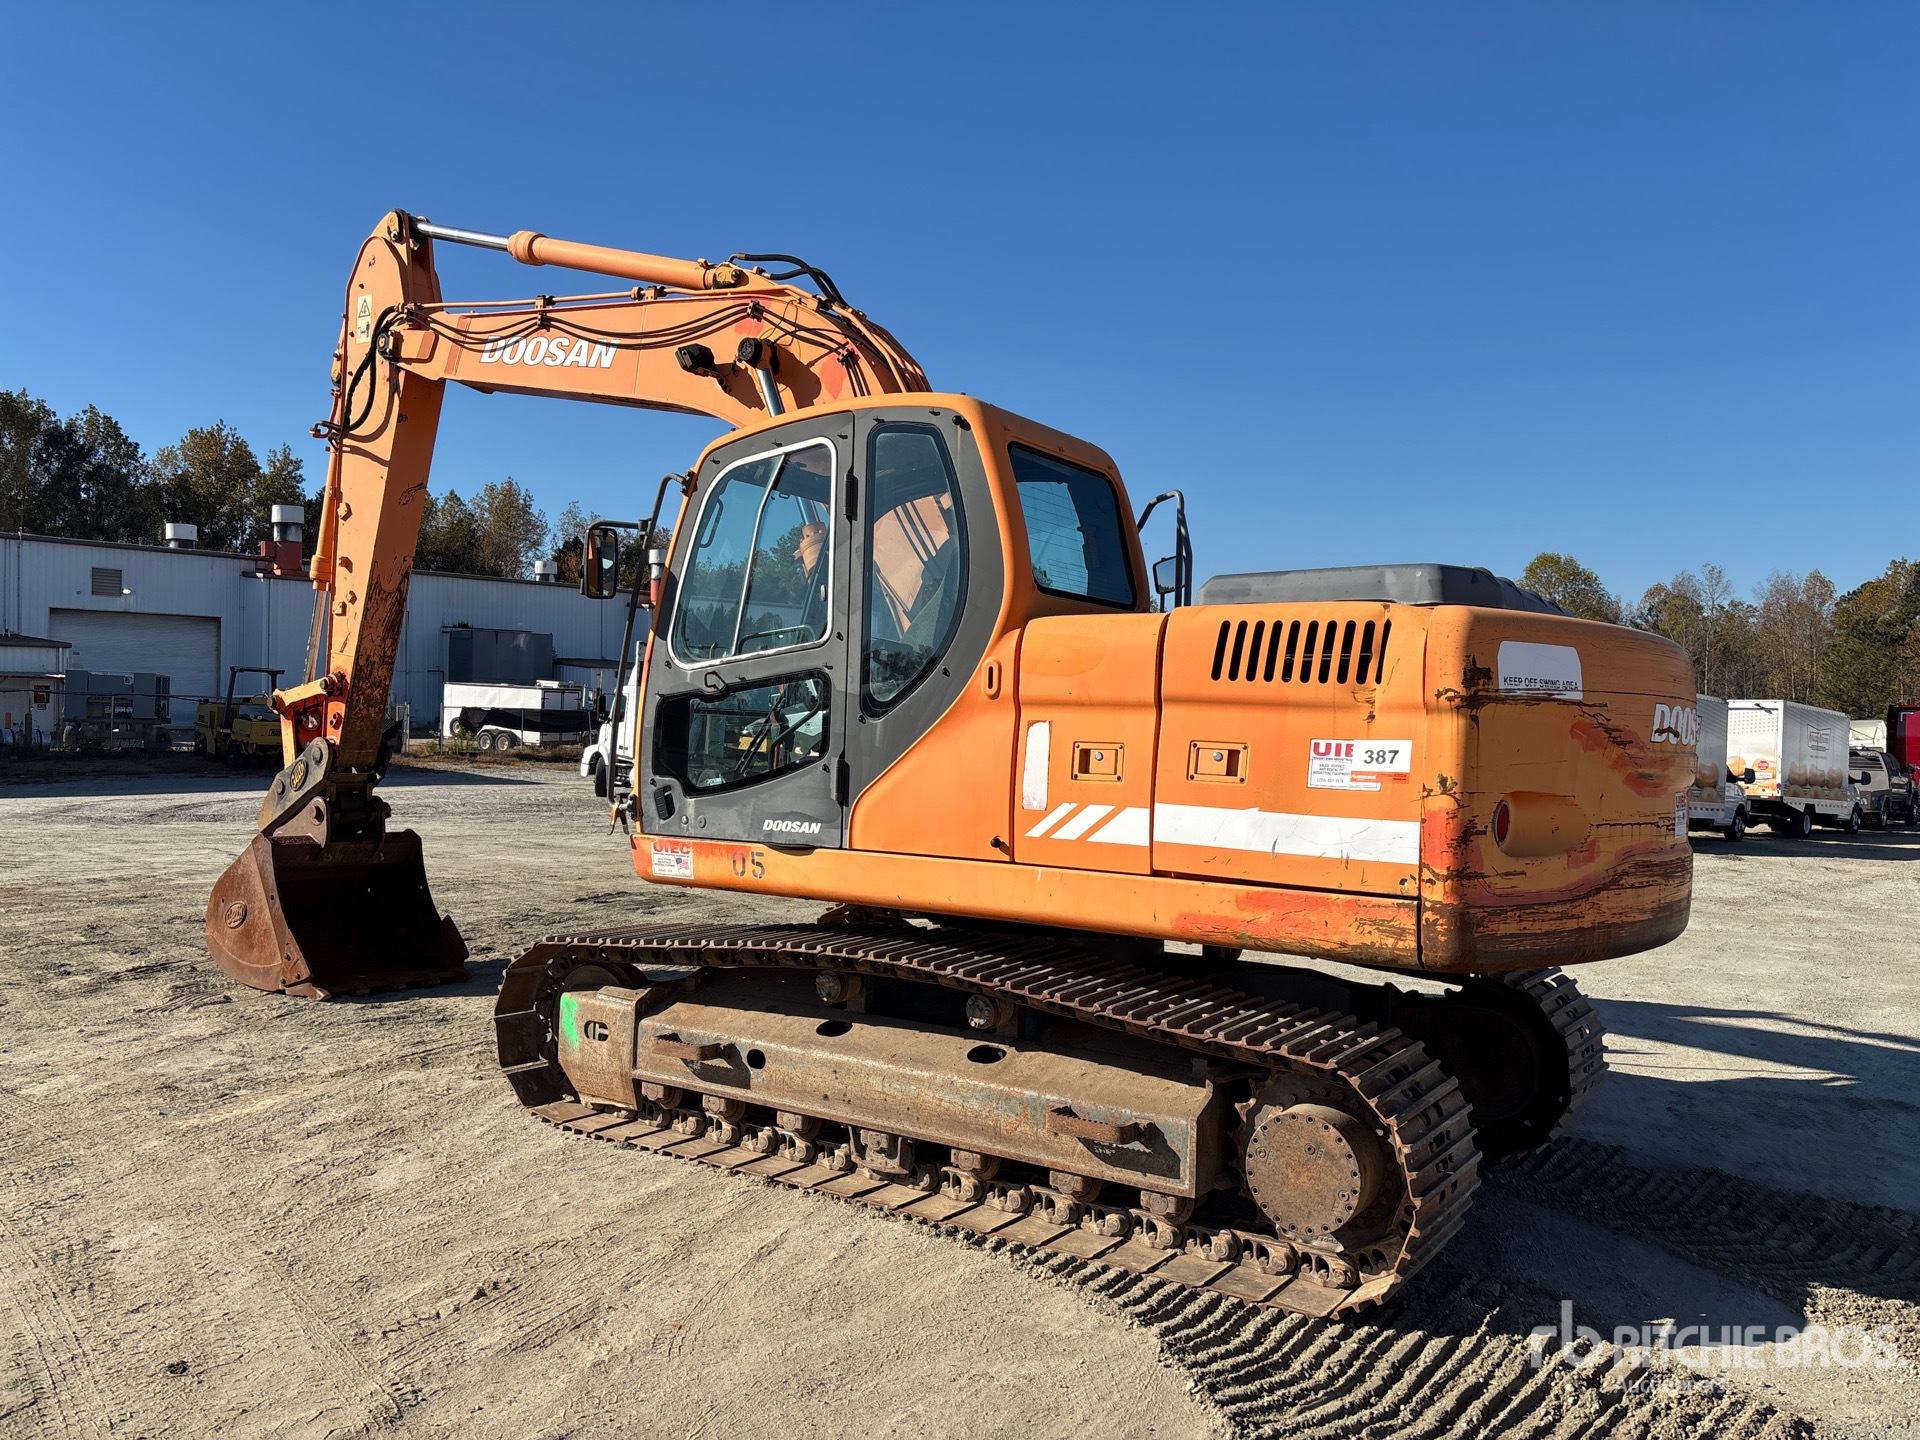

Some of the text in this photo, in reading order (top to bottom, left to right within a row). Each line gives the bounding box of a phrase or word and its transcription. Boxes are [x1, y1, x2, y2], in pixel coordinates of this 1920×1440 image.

[479, 334, 622, 369] DOOSAN
[1363, 749, 1400, 765] 387
[762, 819, 822, 834] DOOSAN
[732, 850, 766, 879] 05
